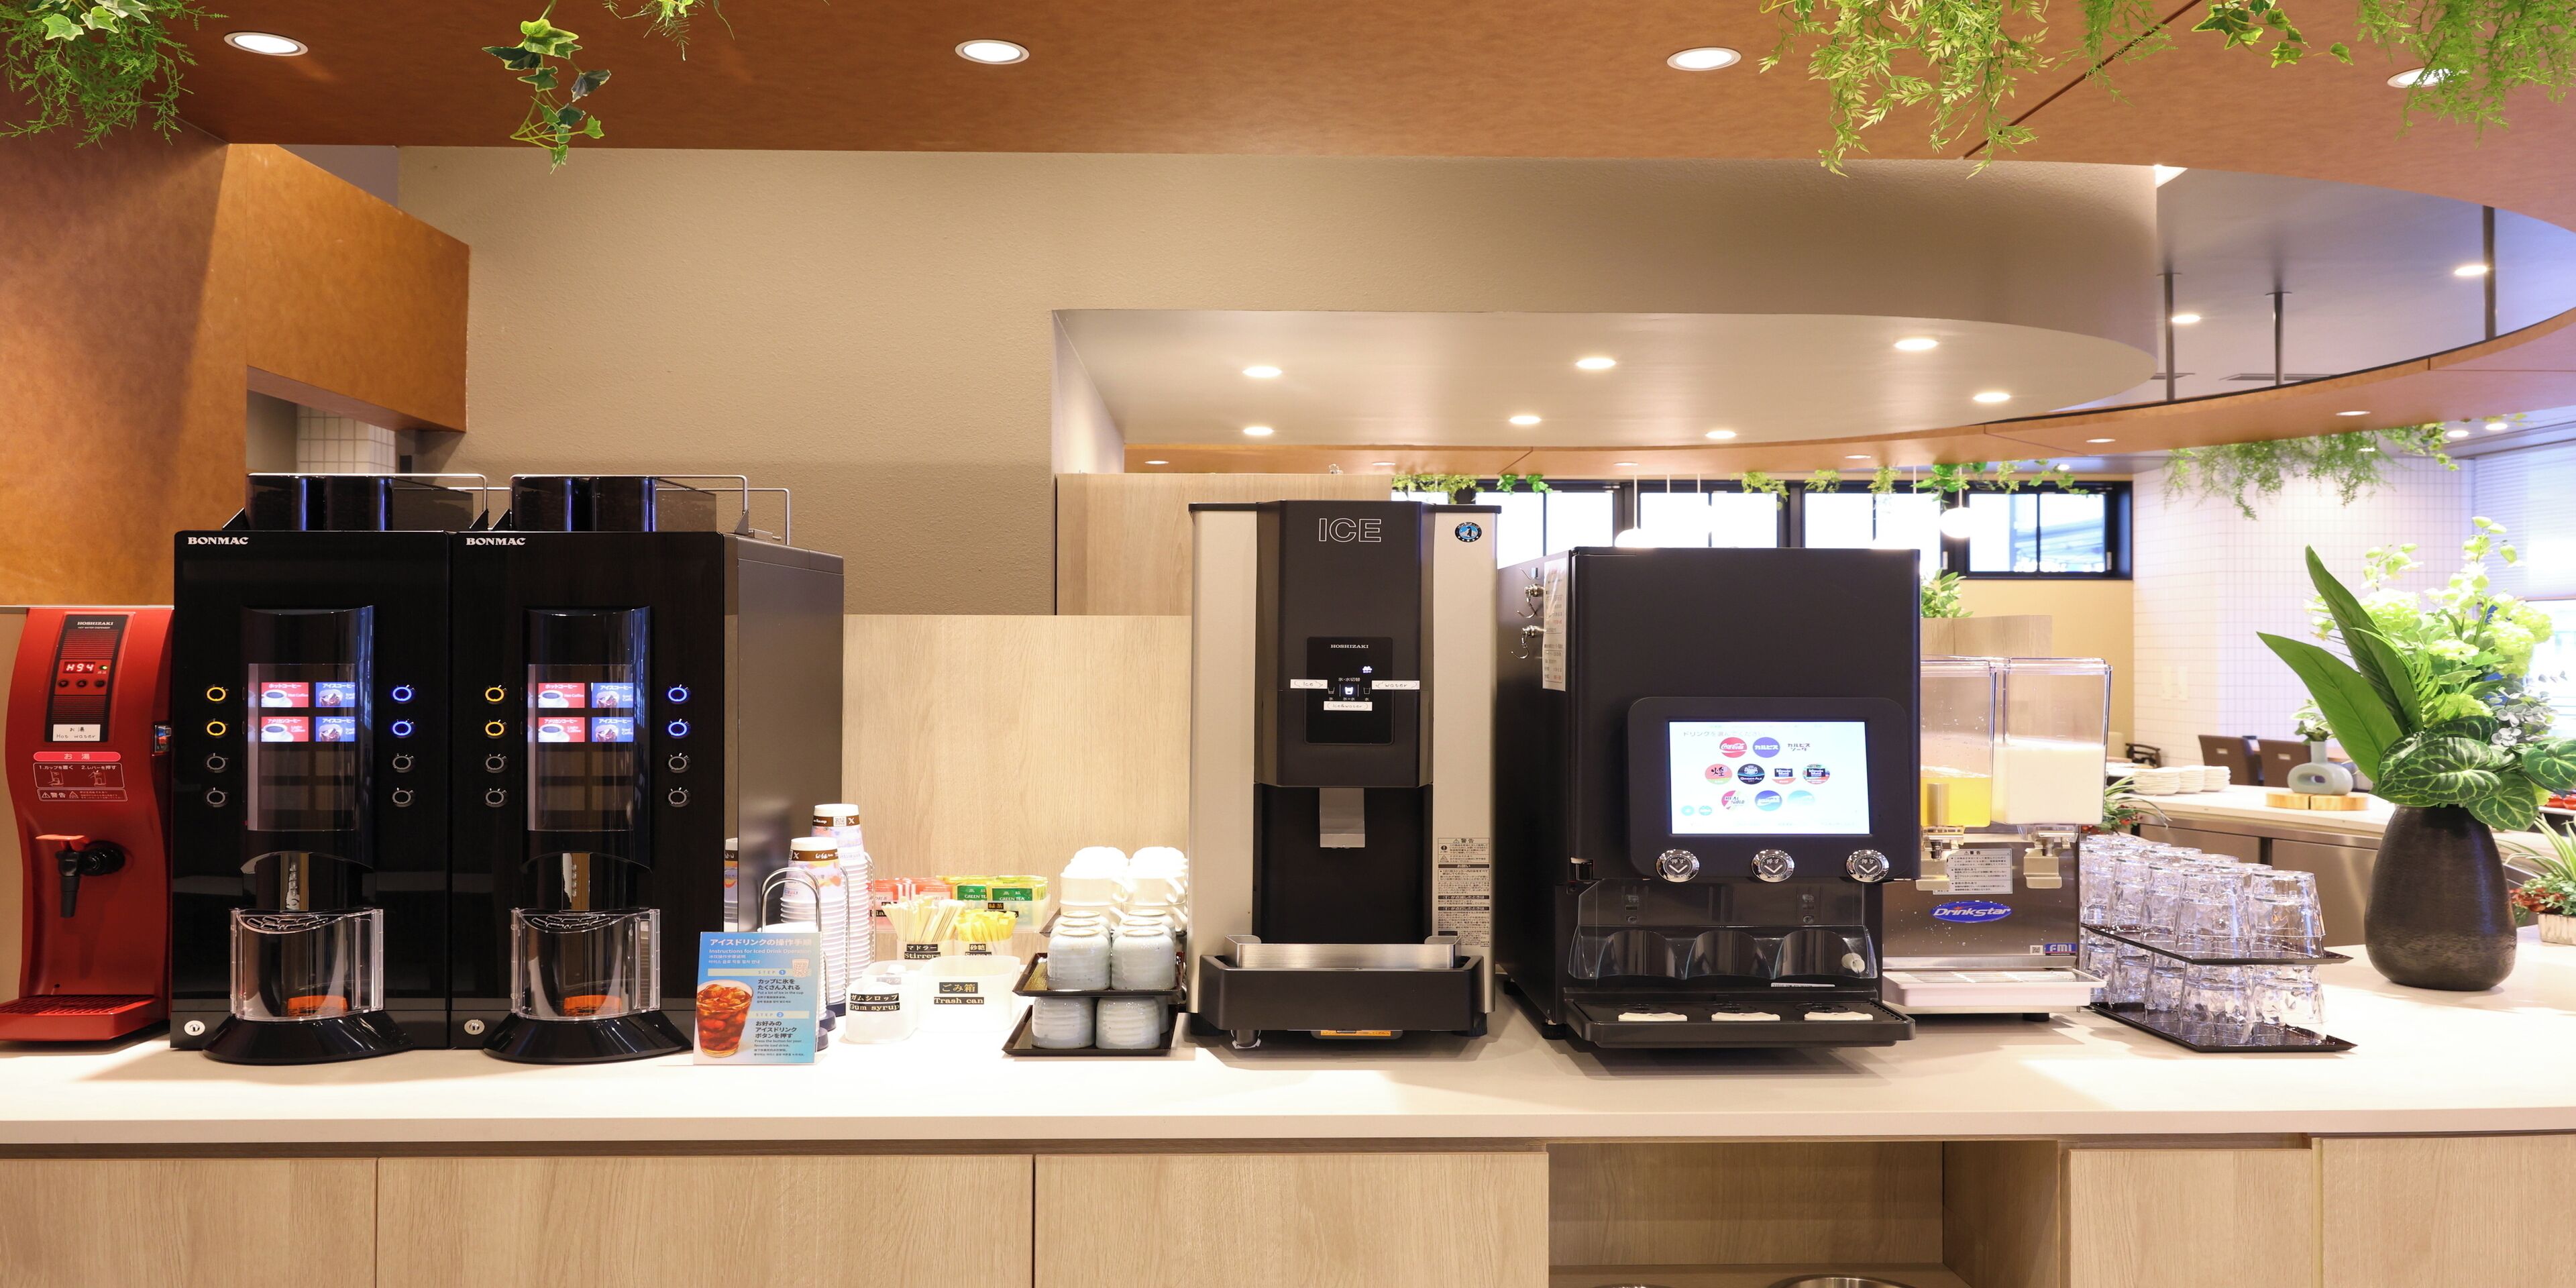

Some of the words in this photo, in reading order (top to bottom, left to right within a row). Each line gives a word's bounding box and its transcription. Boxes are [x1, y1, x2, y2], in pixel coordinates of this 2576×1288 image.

[1319, 518, 1381, 542] ICE
[188, 537, 249, 545] BONMAC
[466, 537, 526, 545] BONMAC
[942, 983, 975, 992] ごみ箱
